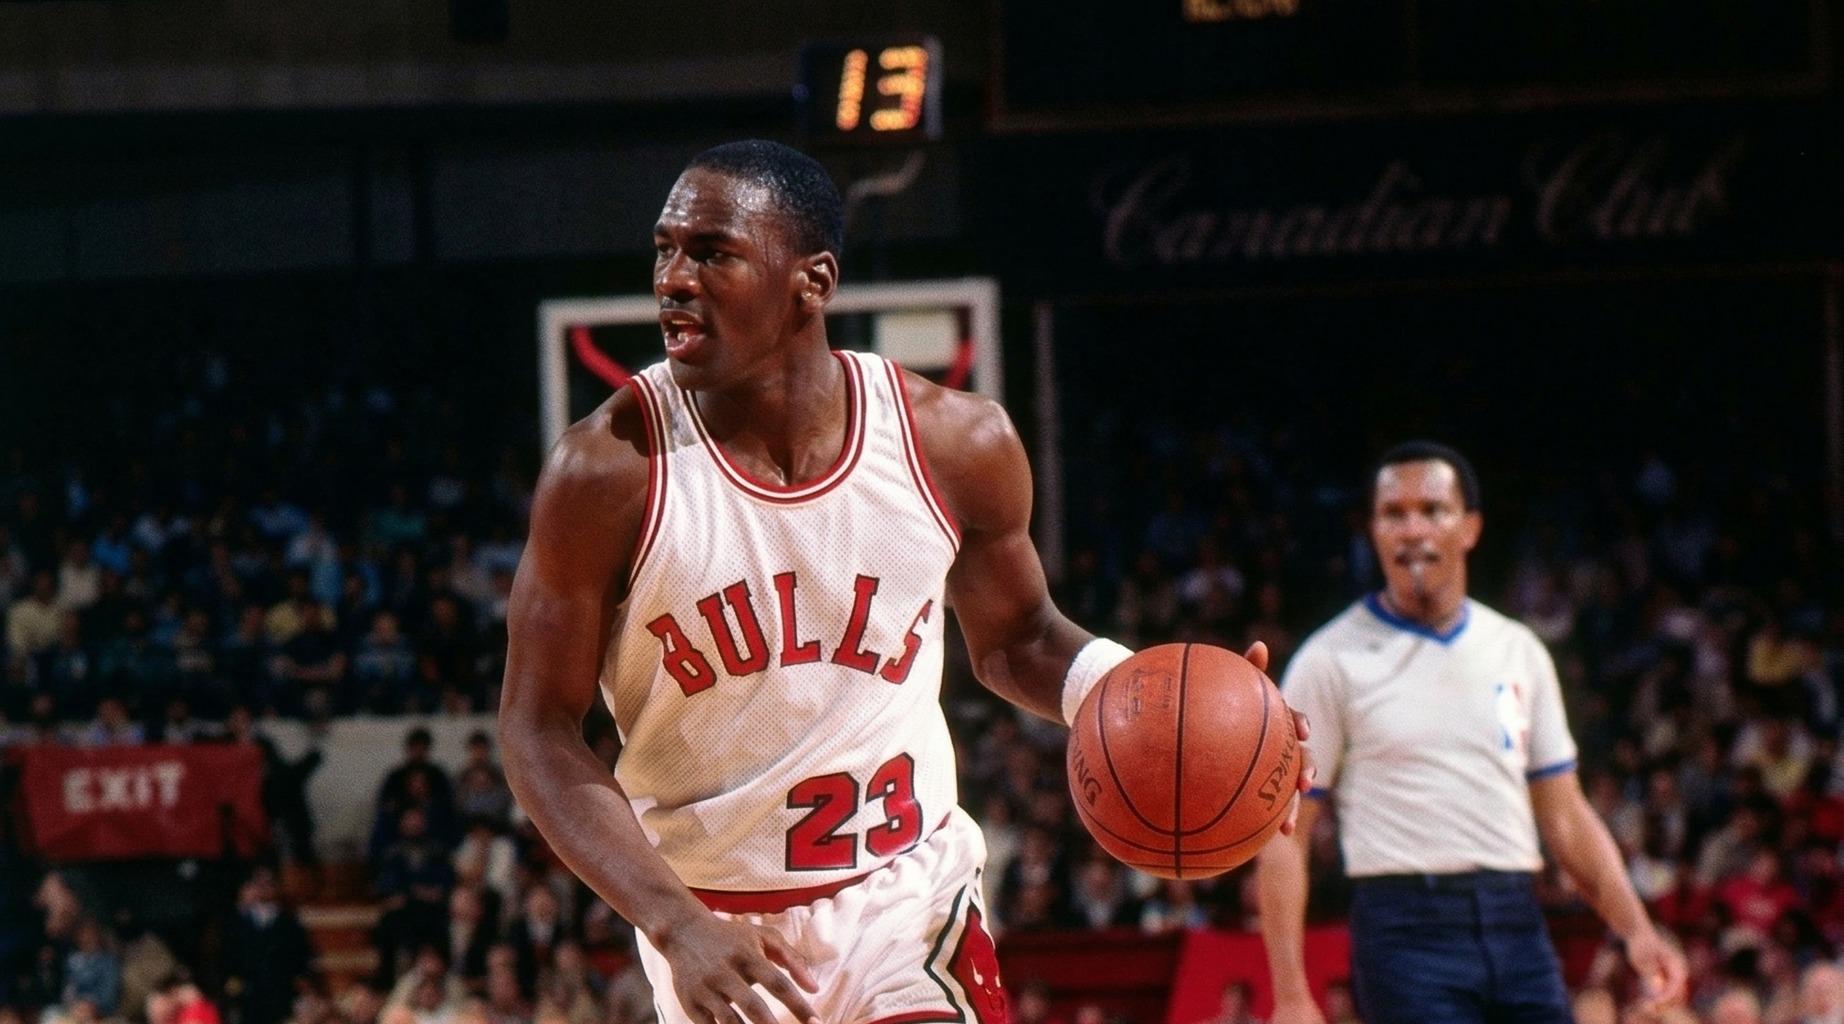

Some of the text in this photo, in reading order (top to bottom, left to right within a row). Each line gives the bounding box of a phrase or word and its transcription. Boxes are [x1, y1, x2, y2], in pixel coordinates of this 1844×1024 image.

[835, 45, 929, 132] 13
[1090, 126, 1754, 268] Canadian Club
[646, 571, 934, 697] BULLS
[61, 760, 187, 814] EXIT
[785, 752, 923, 872] 23
